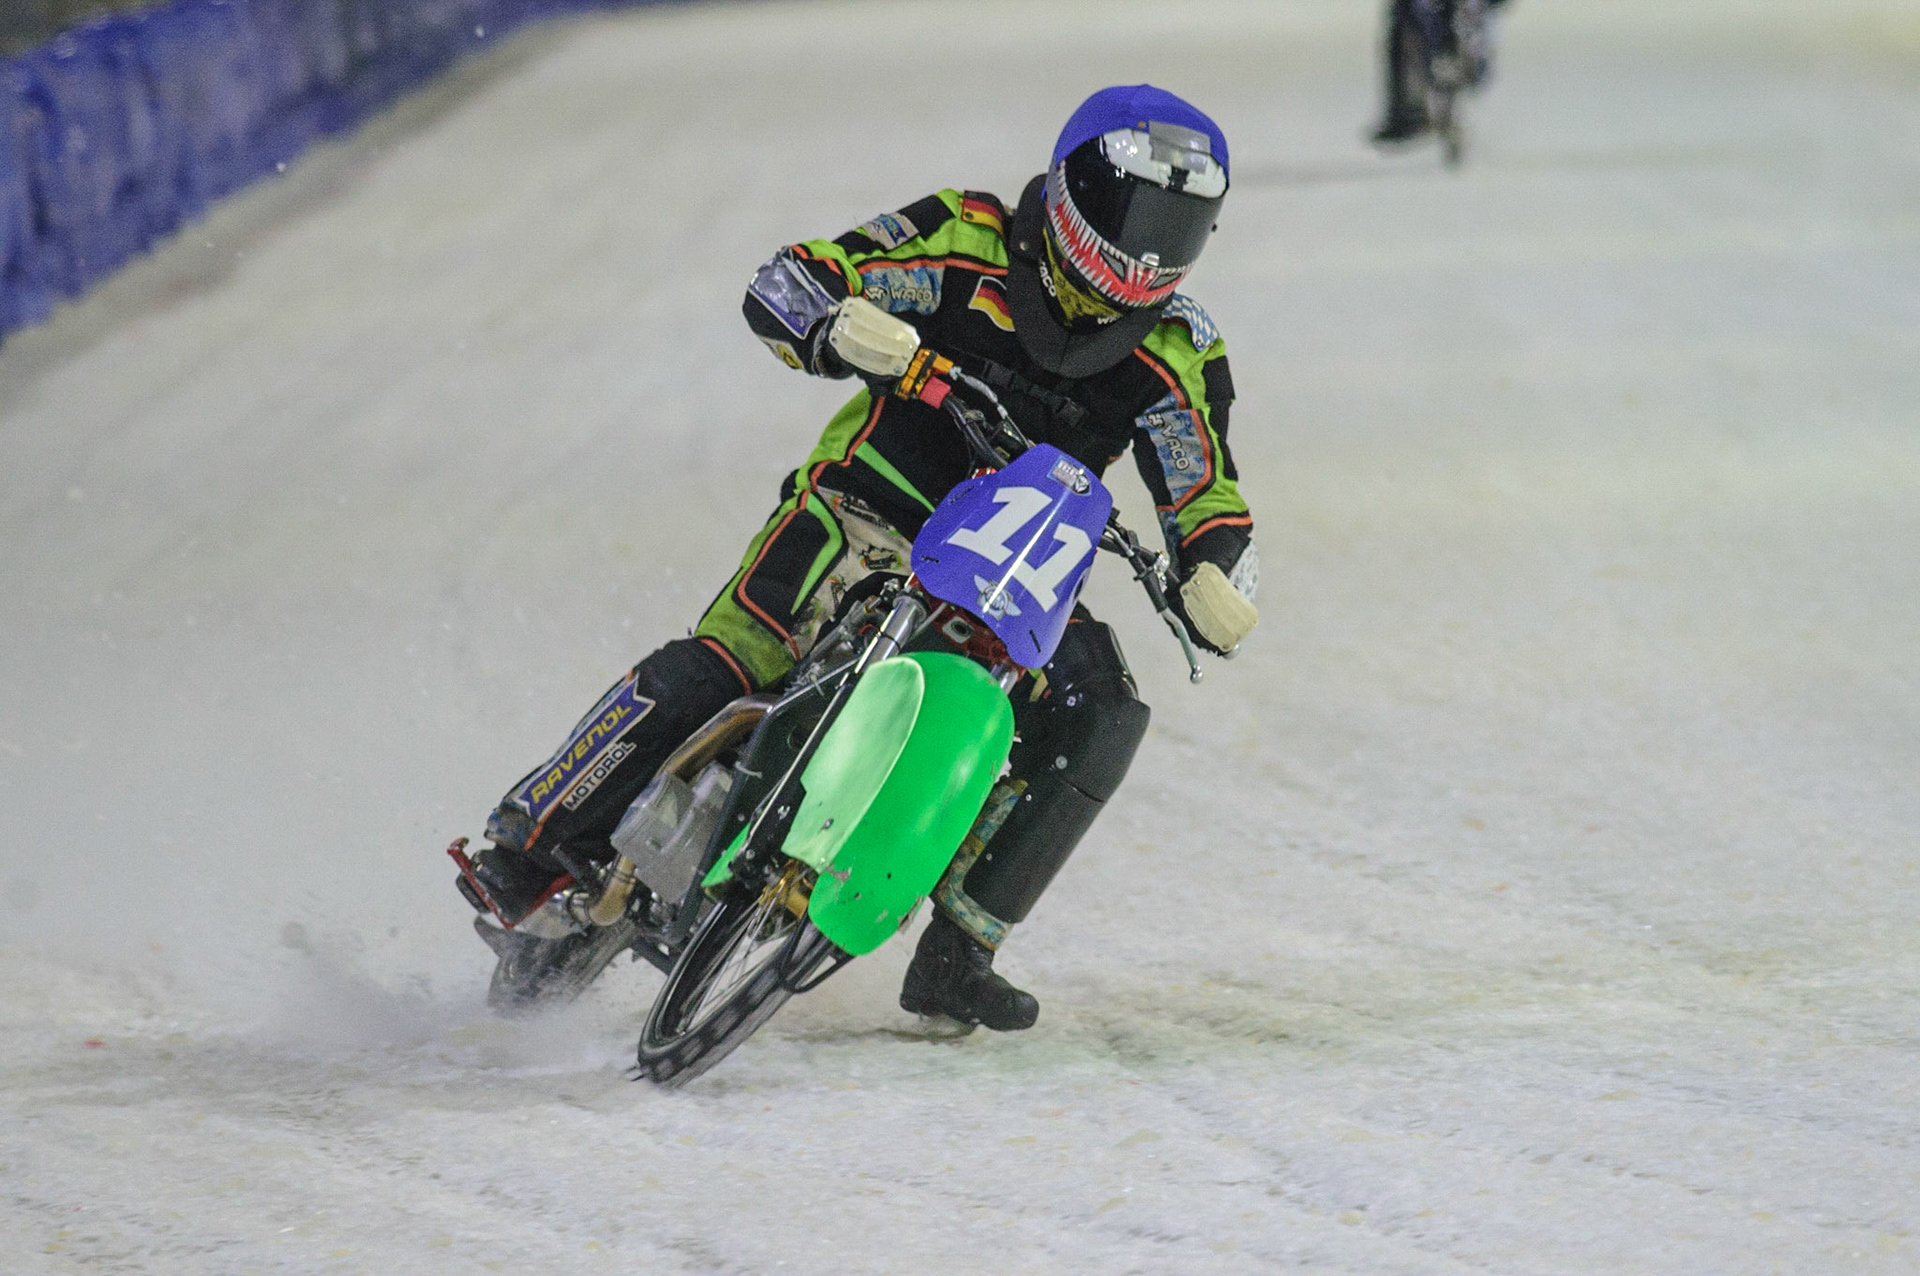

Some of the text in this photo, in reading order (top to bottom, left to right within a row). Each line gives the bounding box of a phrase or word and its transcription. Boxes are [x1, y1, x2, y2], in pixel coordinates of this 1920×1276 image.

[890, 286, 934, 302] WACO
[1038, 260, 1057, 298] ACO
[946, 486, 1093, 614] 11
[530, 705, 632, 803] RAVENOL
[564, 742, 634, 808] MOTORÖL
